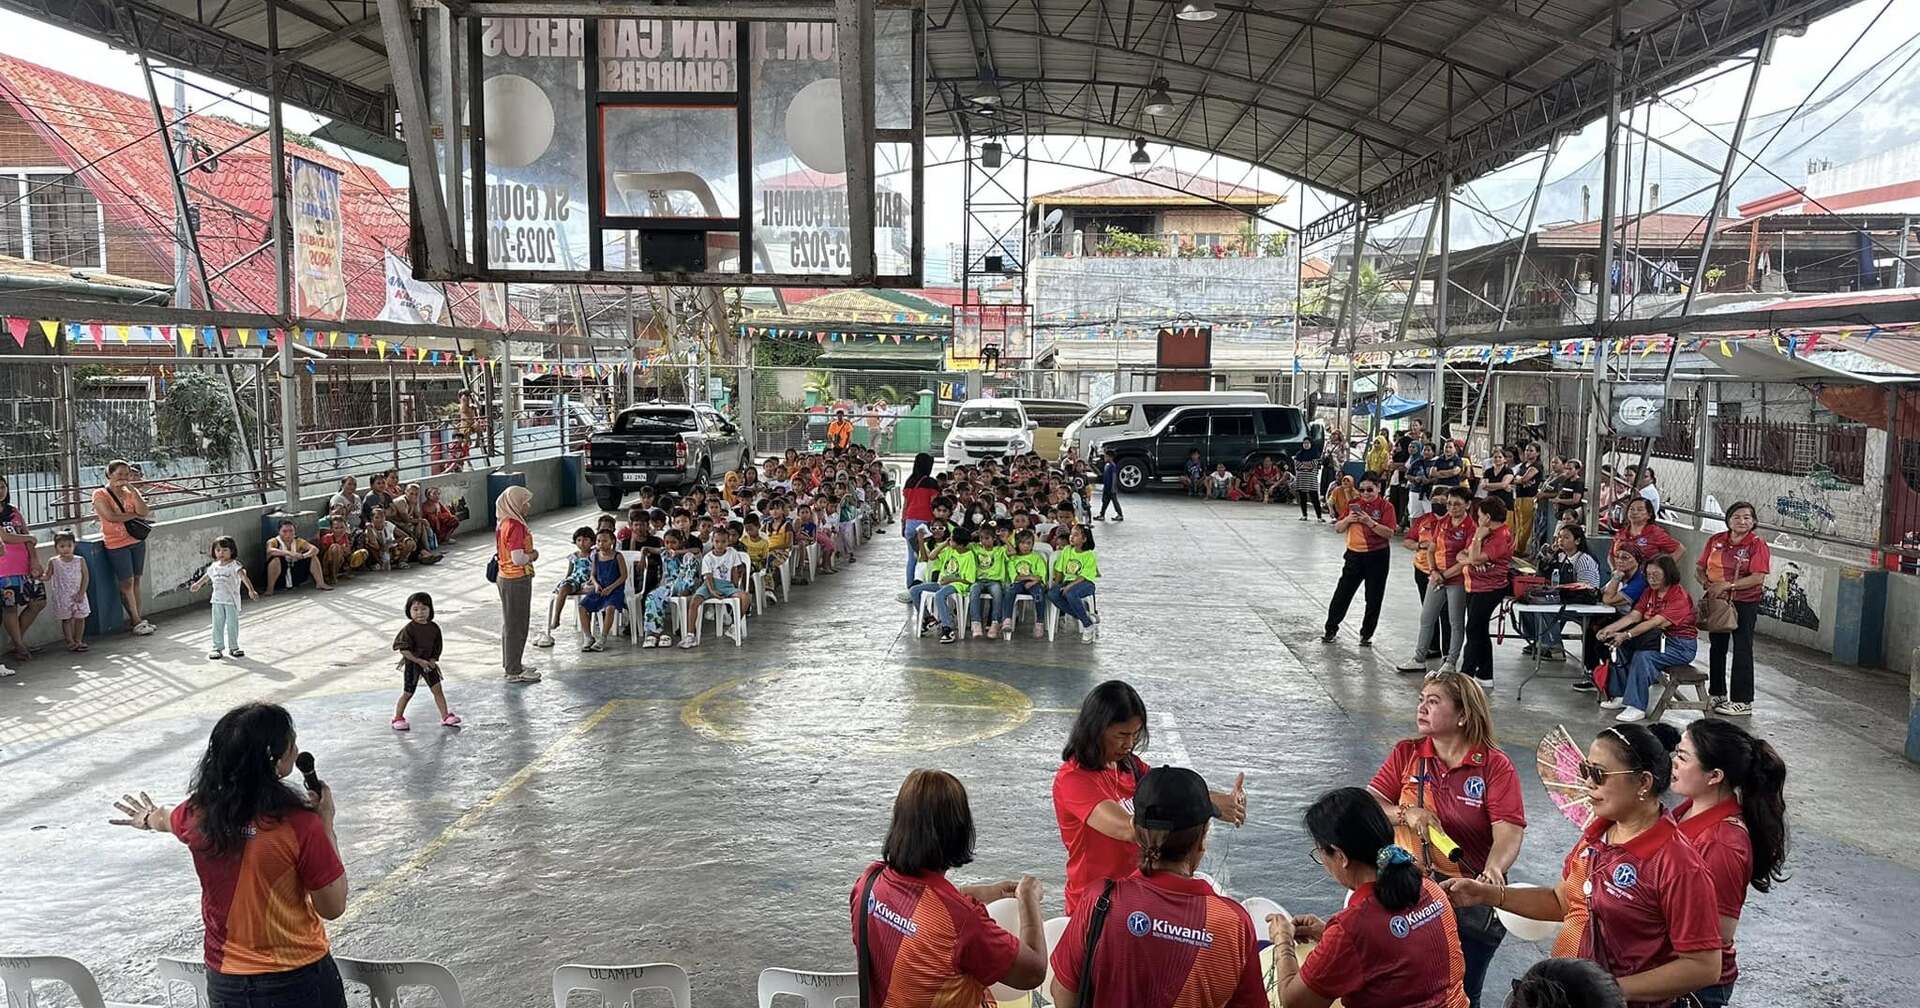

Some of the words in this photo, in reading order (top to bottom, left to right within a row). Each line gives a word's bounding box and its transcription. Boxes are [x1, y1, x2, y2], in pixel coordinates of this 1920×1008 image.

[875, 900, 918, 933] Kiwanis
[1405, 899, 1443, 925] Kiwanis
[1152, 918, 1214, 943] Kiwanis
[589, 967, 644, 980] OCAMPO
